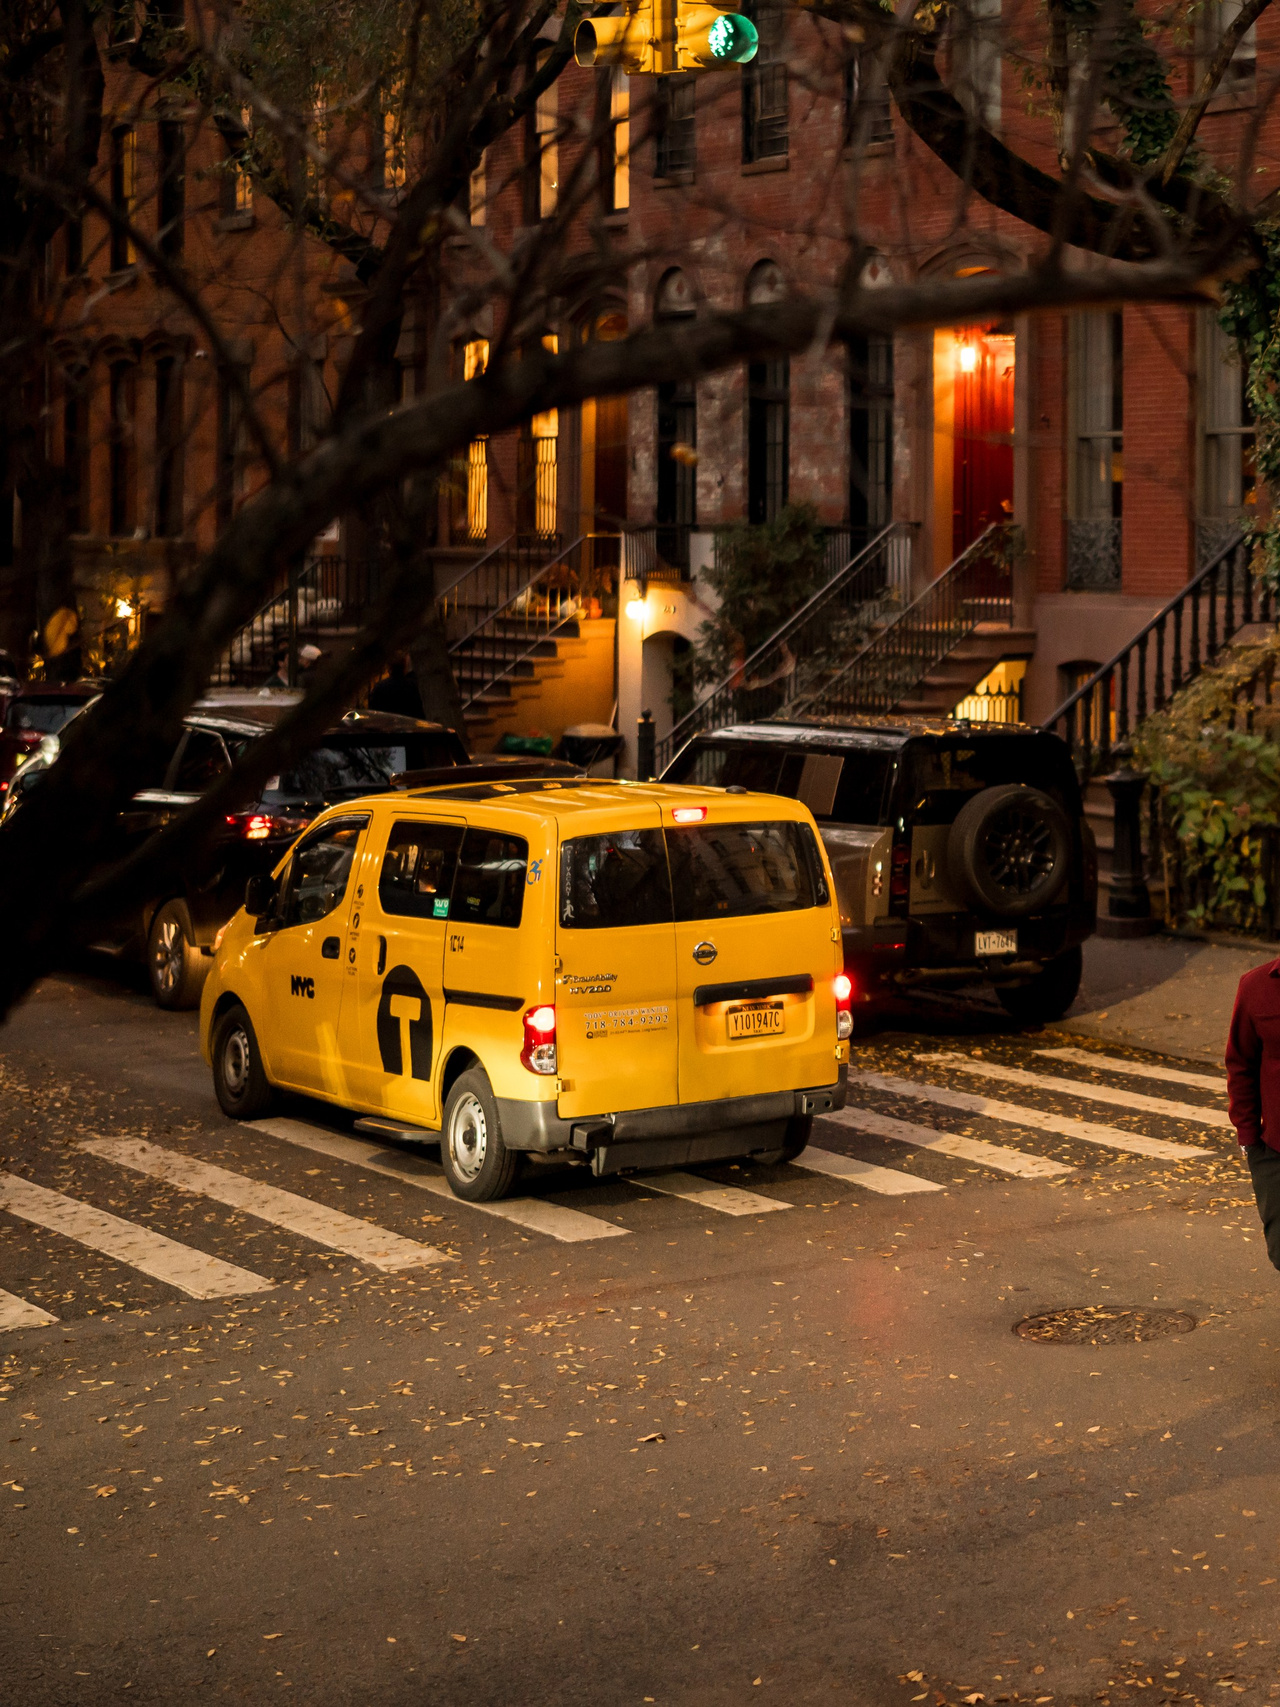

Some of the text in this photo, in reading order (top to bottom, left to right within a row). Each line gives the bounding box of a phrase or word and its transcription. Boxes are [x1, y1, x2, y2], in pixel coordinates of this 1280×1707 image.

[291, 974, 315, 999] NYC
[585, 1015, 669, 1030] 718-784-9292
[733, 1011, 780, 1031] Y101947C
